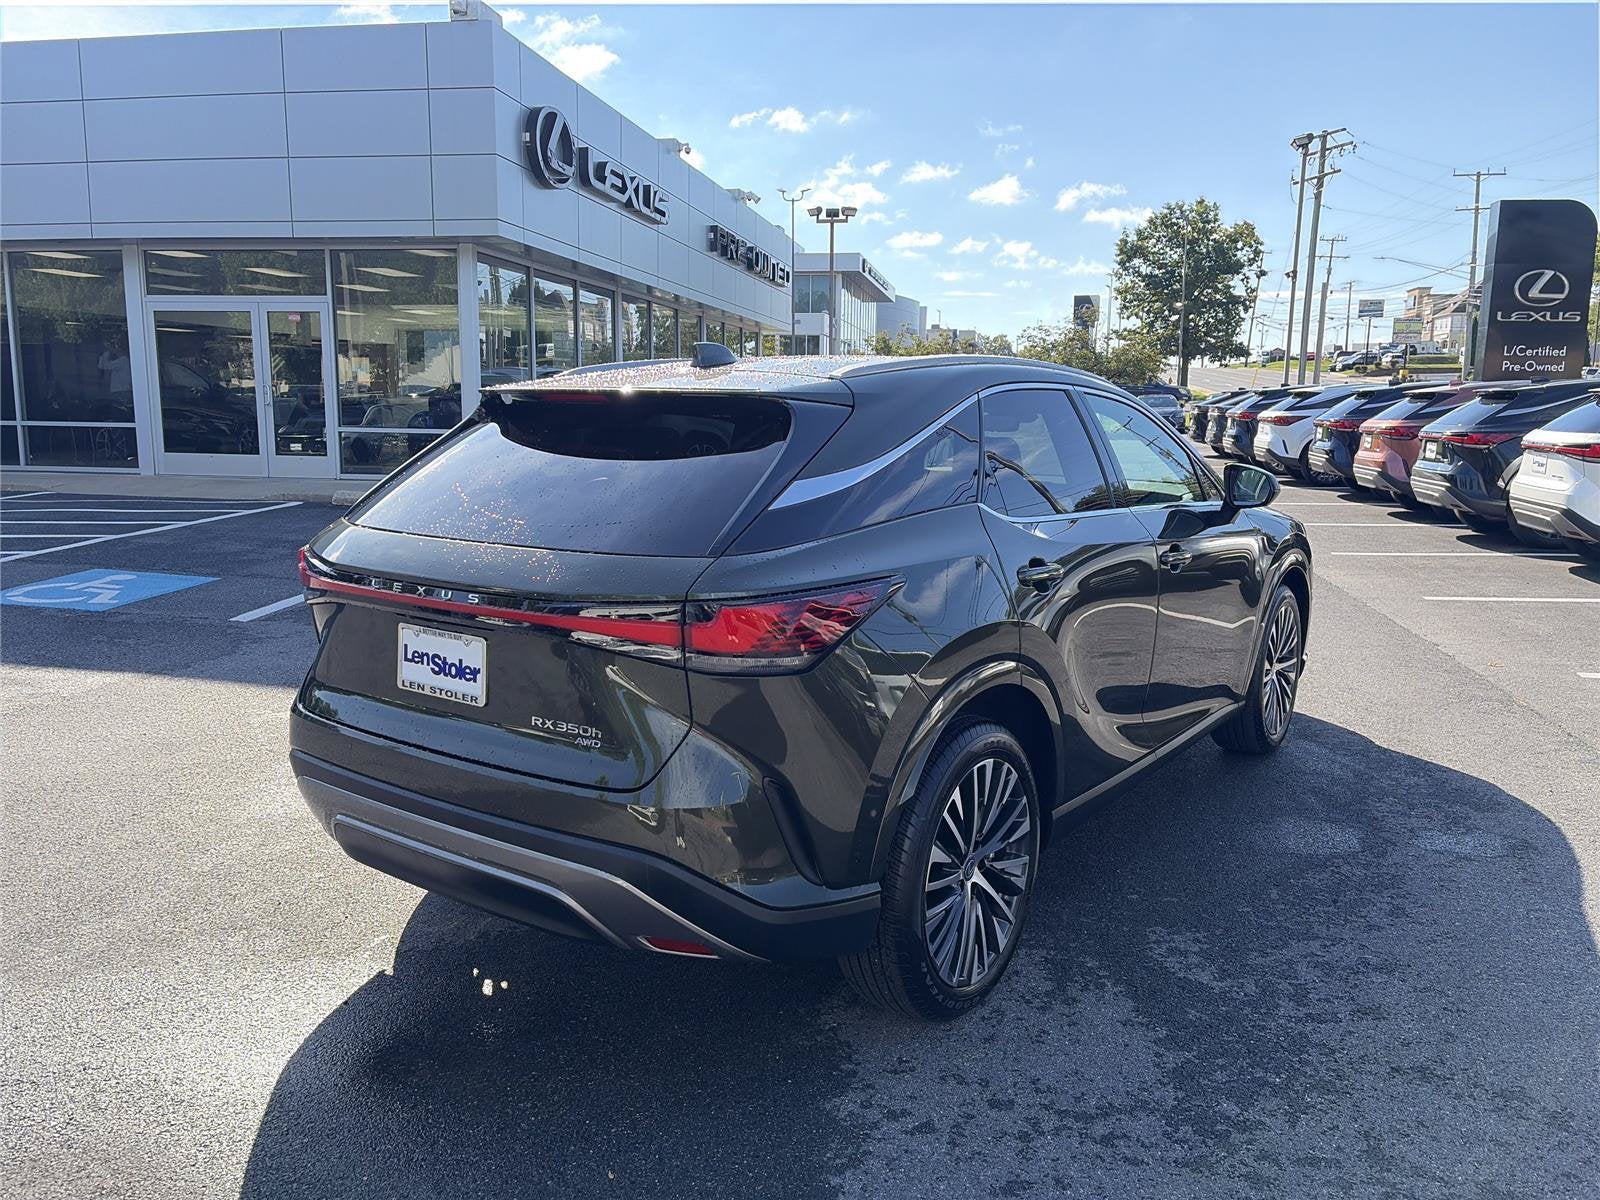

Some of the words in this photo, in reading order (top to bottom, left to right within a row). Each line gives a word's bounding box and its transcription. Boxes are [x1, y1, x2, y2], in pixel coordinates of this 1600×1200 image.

[577, 146, 670, 225] LEXUS
[1496, 311, 1582, 322] LEXUS
[1503, 345, 1567, 357] L/Certified
[1502, 361, 1565, 372] Pre-Owned
[371, 578, 480, 604] LEXUS
[401, 679, 425, 691] LEN
[429, 686, 479, 704] STOLER
[531, 715, 602, 738] RX350h
[574, 737, 601, 748] AWD
